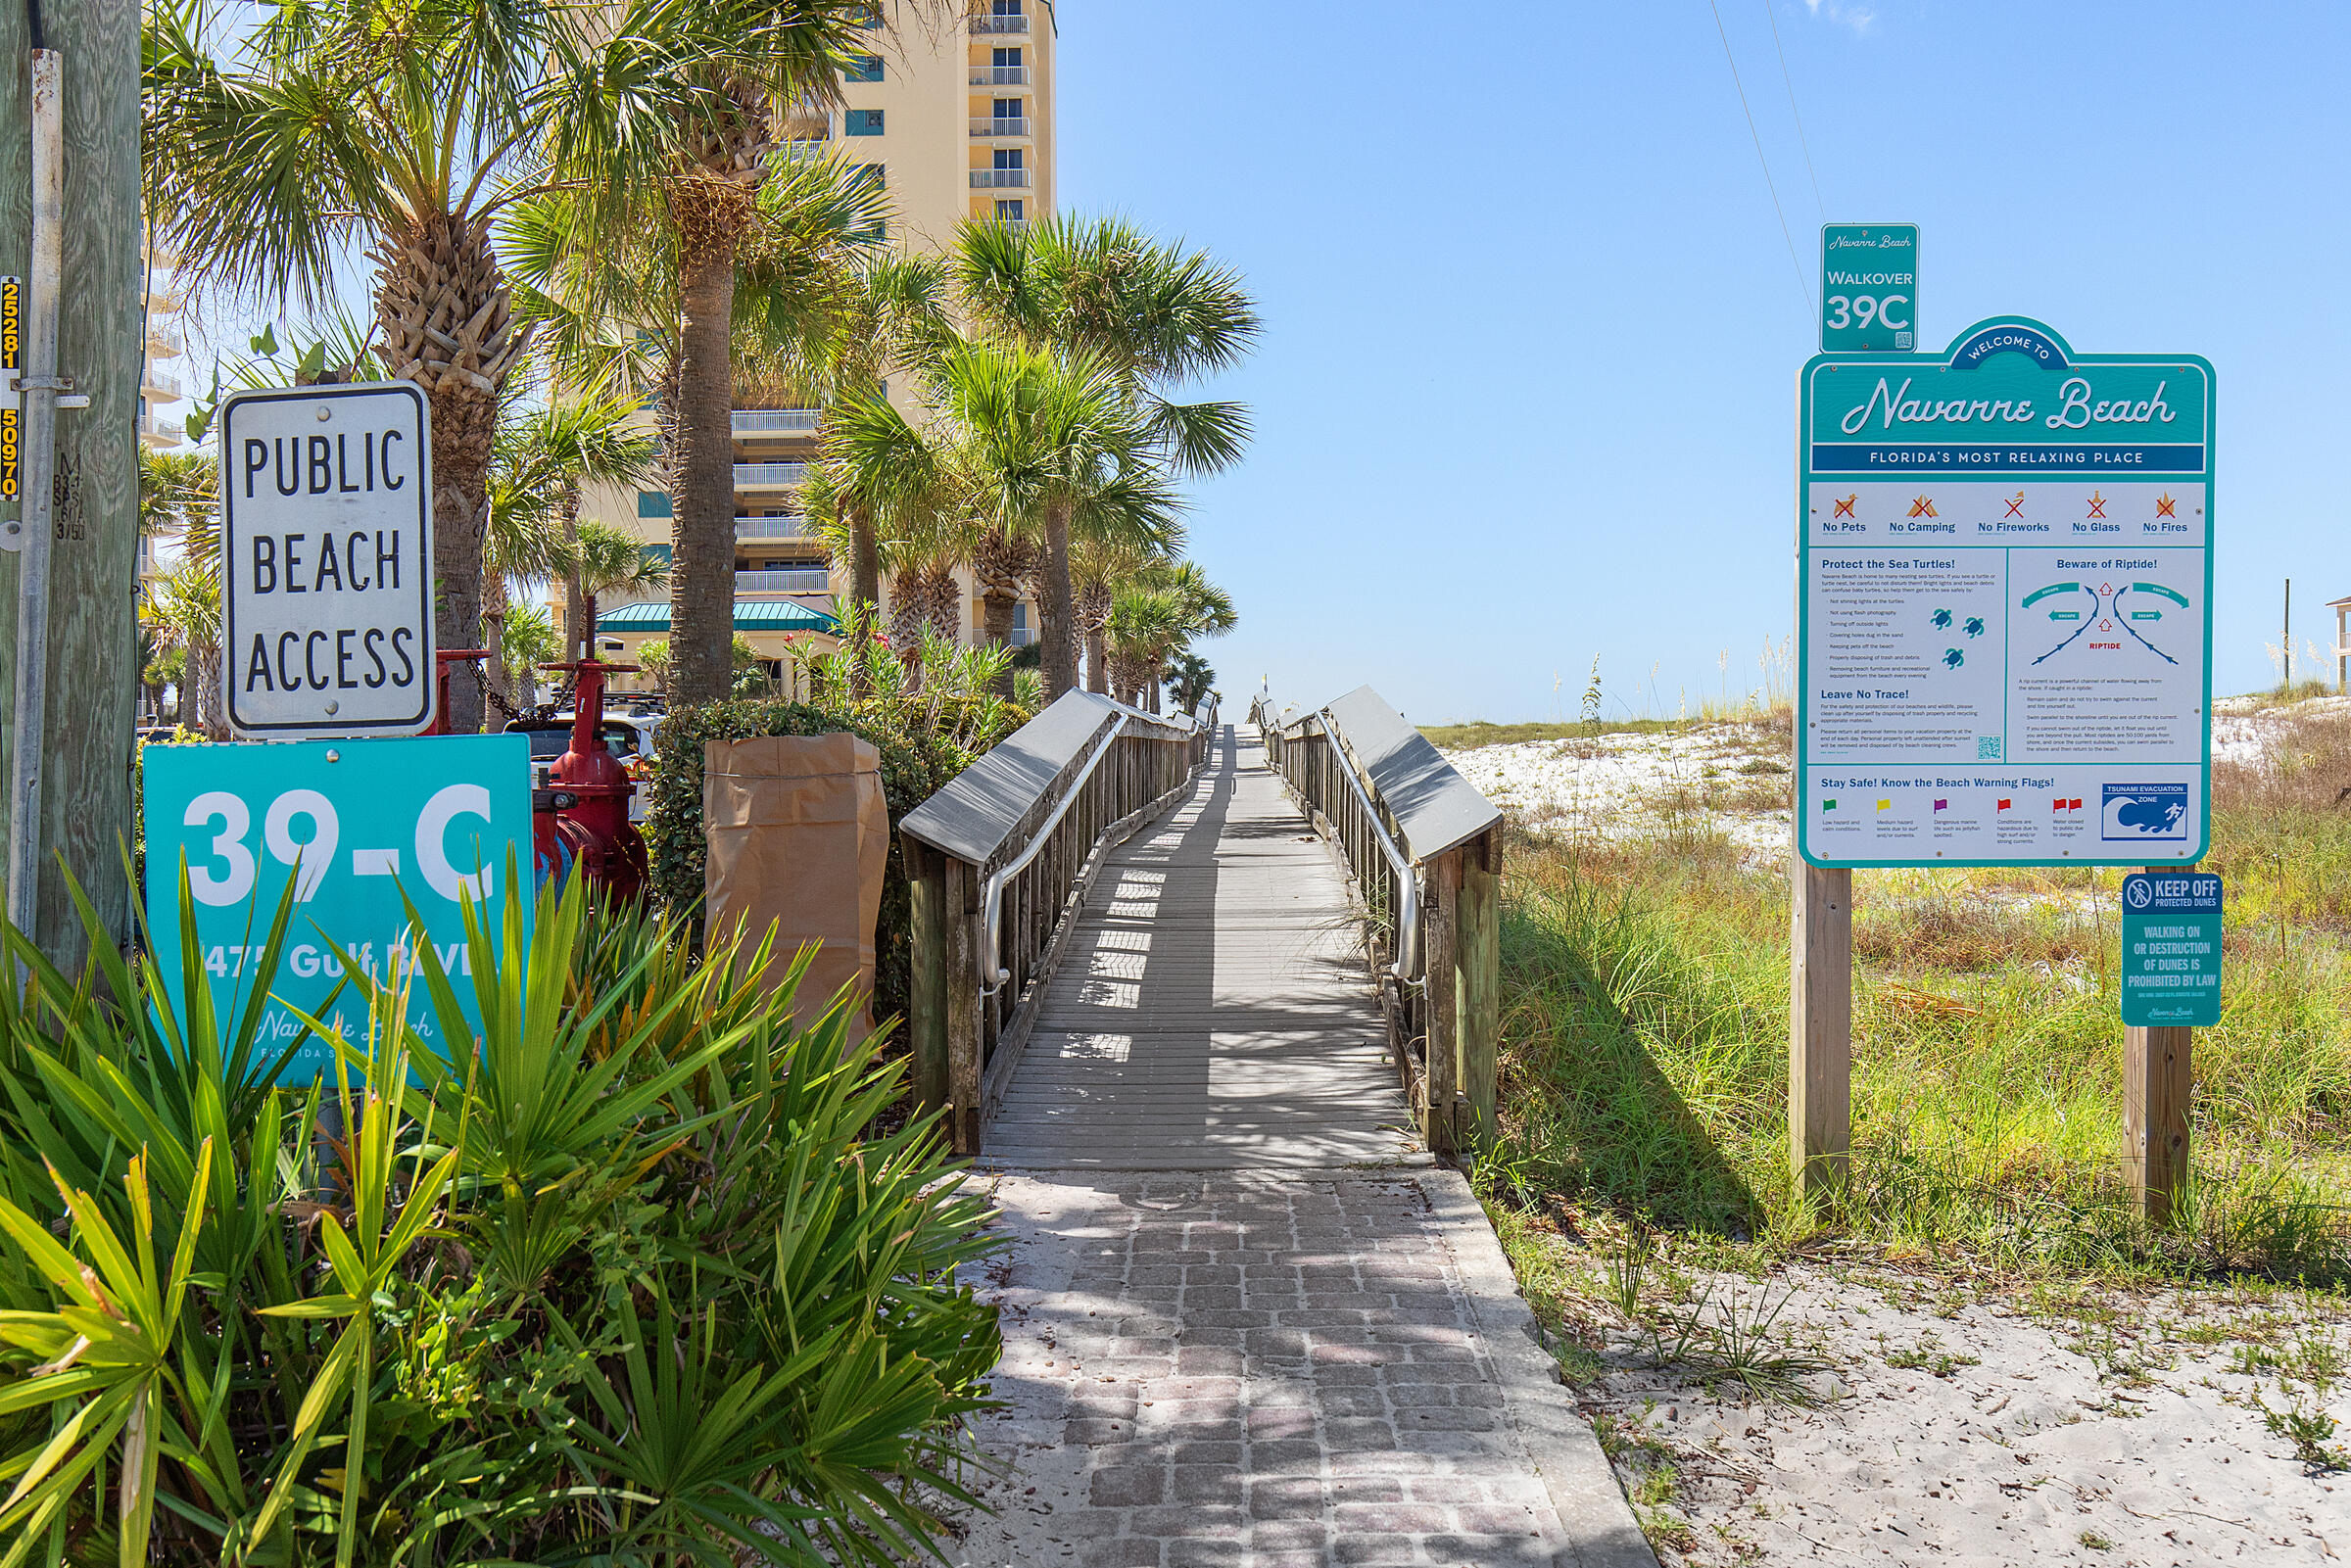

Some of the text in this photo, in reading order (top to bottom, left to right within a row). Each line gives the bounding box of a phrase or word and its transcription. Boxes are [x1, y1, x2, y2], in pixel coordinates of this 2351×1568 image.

[1829, 234, 1912, 250] Navarre Beach
[1827, 271, 1913, 285] WALKOVER
[1827, 295, 1909, 329] 39C
[3, 284, 18, 368] 25281
[1968, 336, 2049, 359] WELCOME TO
[1841, 377, 2176, 434] Navarre Beach
[2, 410, 17, 495] 50970
[1870, 451, 2143, 463] FLORIDA'S MOST RELAXING PLACE
[245, 430, 405, 498] PUBLIC
[1823, 522, 1866, 531] No Pets
[1889, 522, 1956, 533] No Camping
[1978, 522, 2049, 531] No Fireworks
[2072, 522, 2120, 532] No Glass
[2143, 522, 2188, 531] No Fires
[254, 530, 400, 594] BEACH
[1822, 559, 1955, 569] Protect the Sea Turtles!
[2057, 559, 2157, 570] Beware of Riptide!
[246, 627, 414, 692] ACCESS
[1821, 690, 1909, 699] Leave No Trace!
[1821, 778, 2054, 789] Stay Safe! Know the Beach Warning Flags!
[183, 784, 493, 906] 39-C
[2156, 880, 2217, 897] KEEP OFF
[2155, 898, 2216, 907] PROTECTED DUNES
[2144, 926, 2200, 938] WALKING ON
[2134, 942, 2210, 955] OR DESTRUCTION
[2144, 959, 2200, 970] OF DUNES IS
[2128, 975, 2216, 987] PROHIBITED BY LAW
